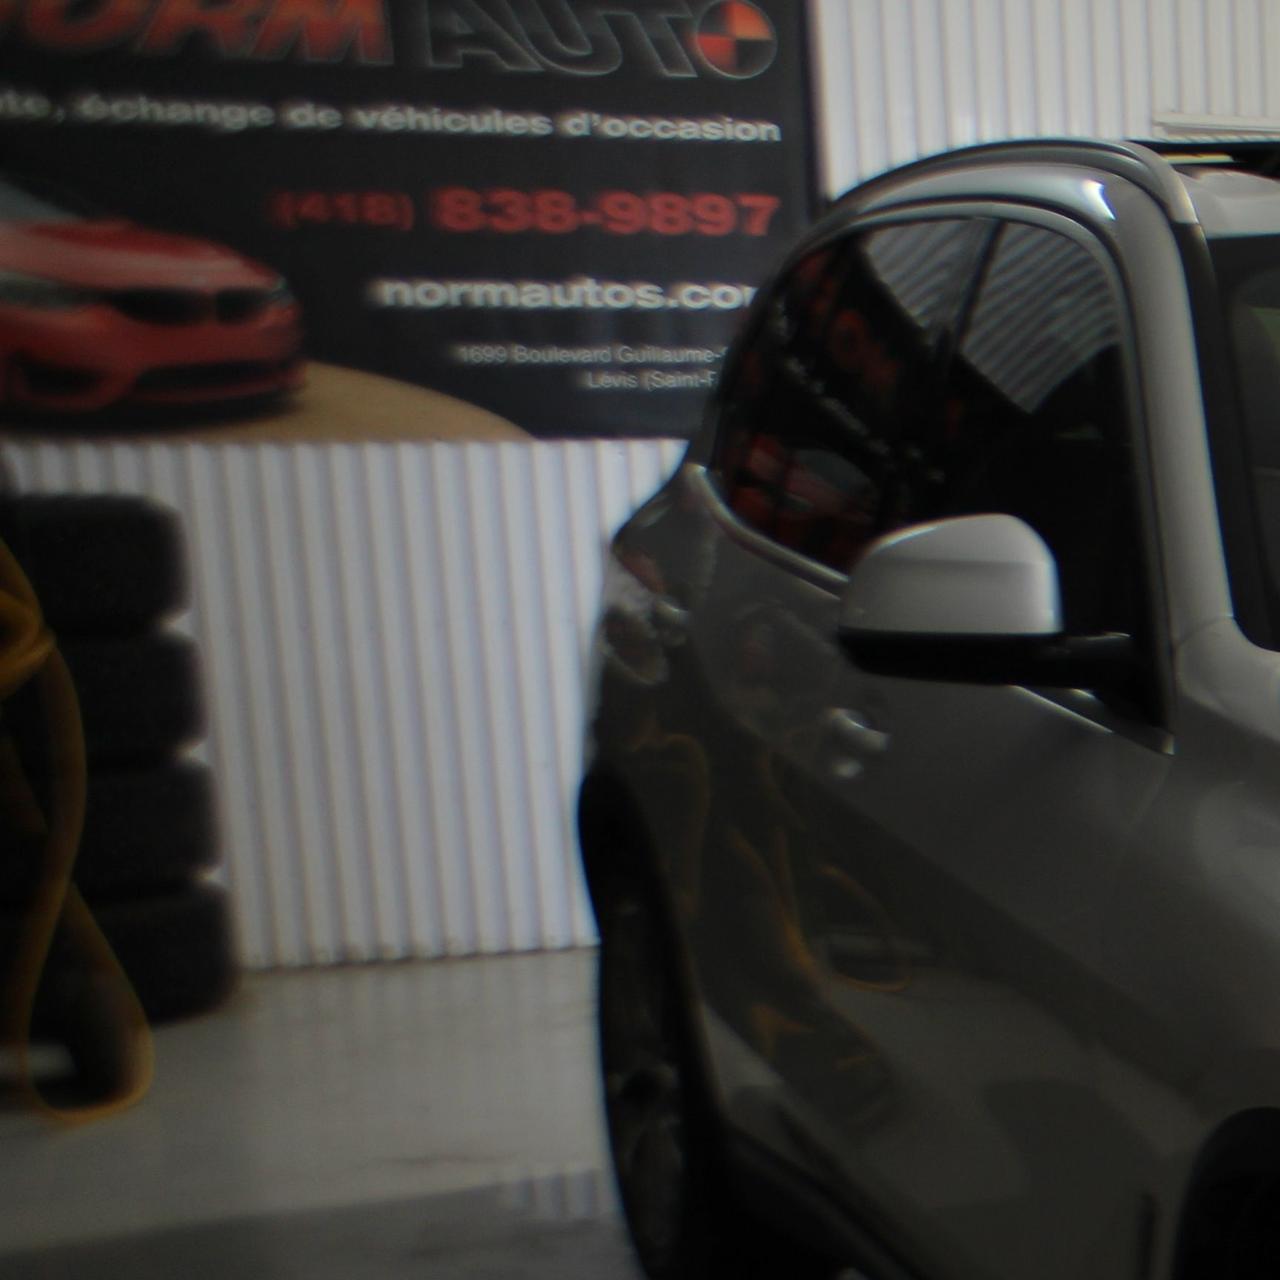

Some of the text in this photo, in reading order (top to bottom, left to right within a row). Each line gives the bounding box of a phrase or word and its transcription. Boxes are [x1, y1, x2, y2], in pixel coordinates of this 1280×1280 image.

[0, 0, 394, 64] ORM
[77, 92, 275, 131] échange
[287, 101, 343, 128] de
[354, 105, 553, 136] véhicules
[565, 112, 781, 141] d'occasion
[433, 189, 780, 236] 838-9897
[514, 345, 612, 364] Boulevard
